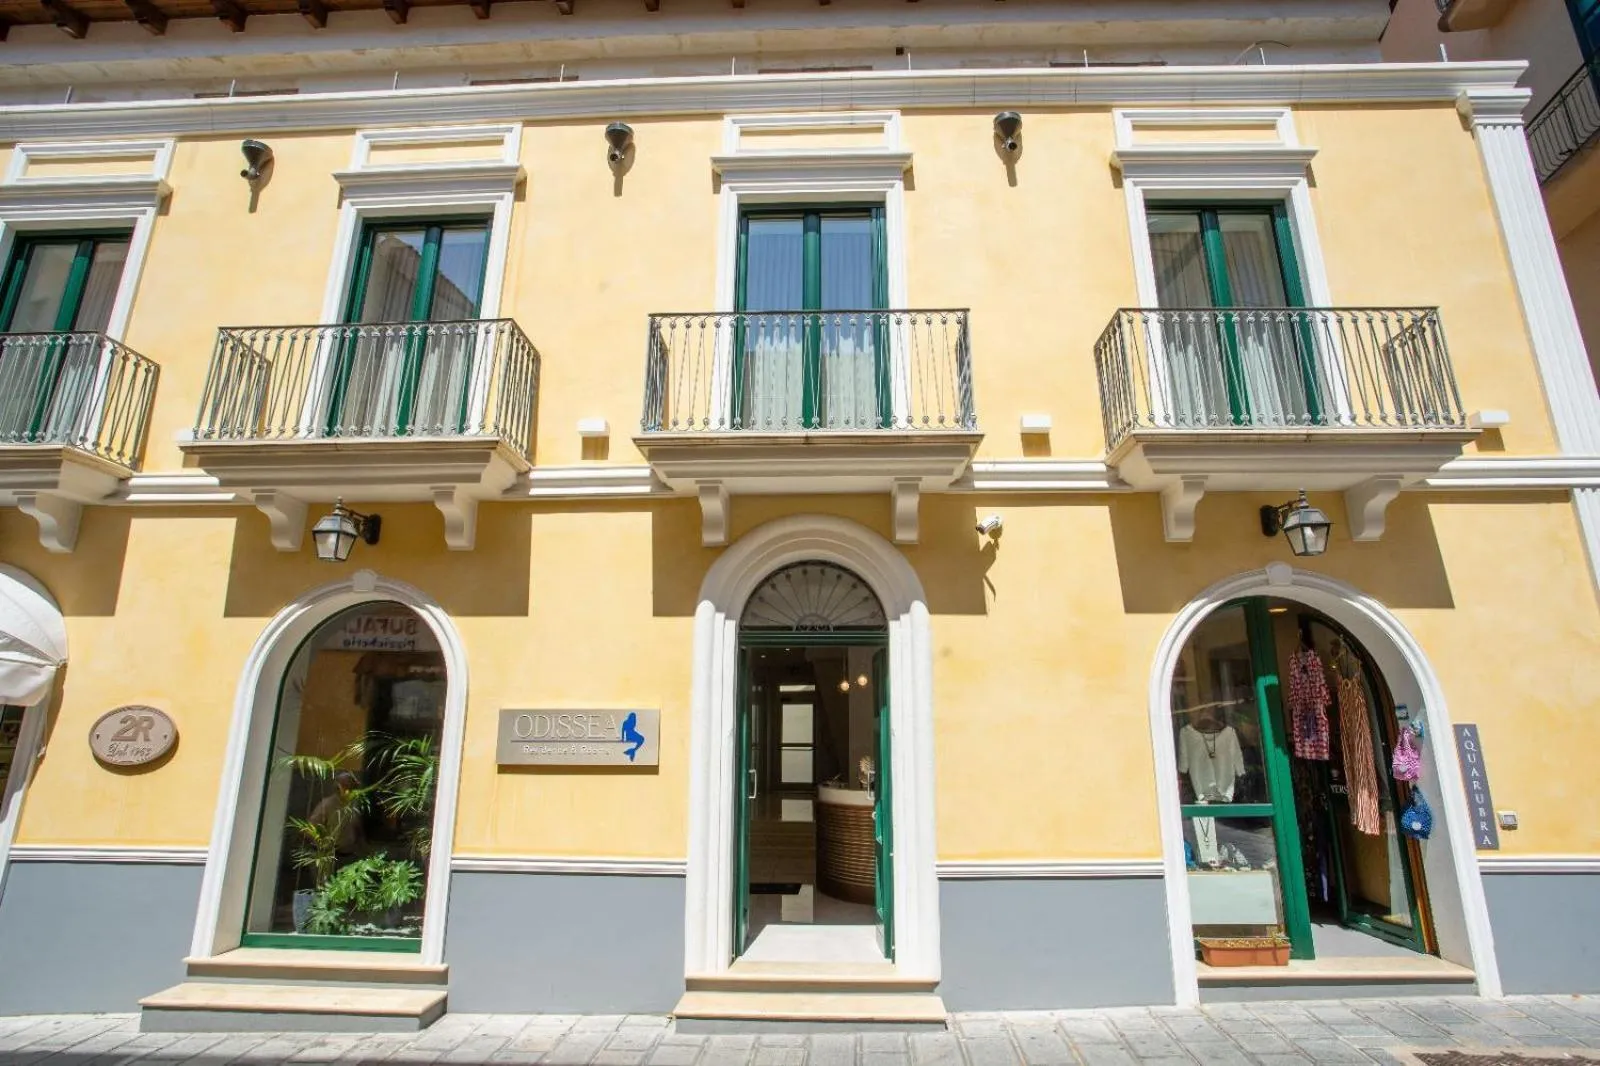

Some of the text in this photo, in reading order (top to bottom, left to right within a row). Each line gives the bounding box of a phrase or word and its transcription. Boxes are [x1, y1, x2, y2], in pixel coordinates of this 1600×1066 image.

[110, 713, 155, 742] 2R
[514, 713, 621, 739] ODISSEA
[1462, 727, 1492, 846] AQUARUBRA
